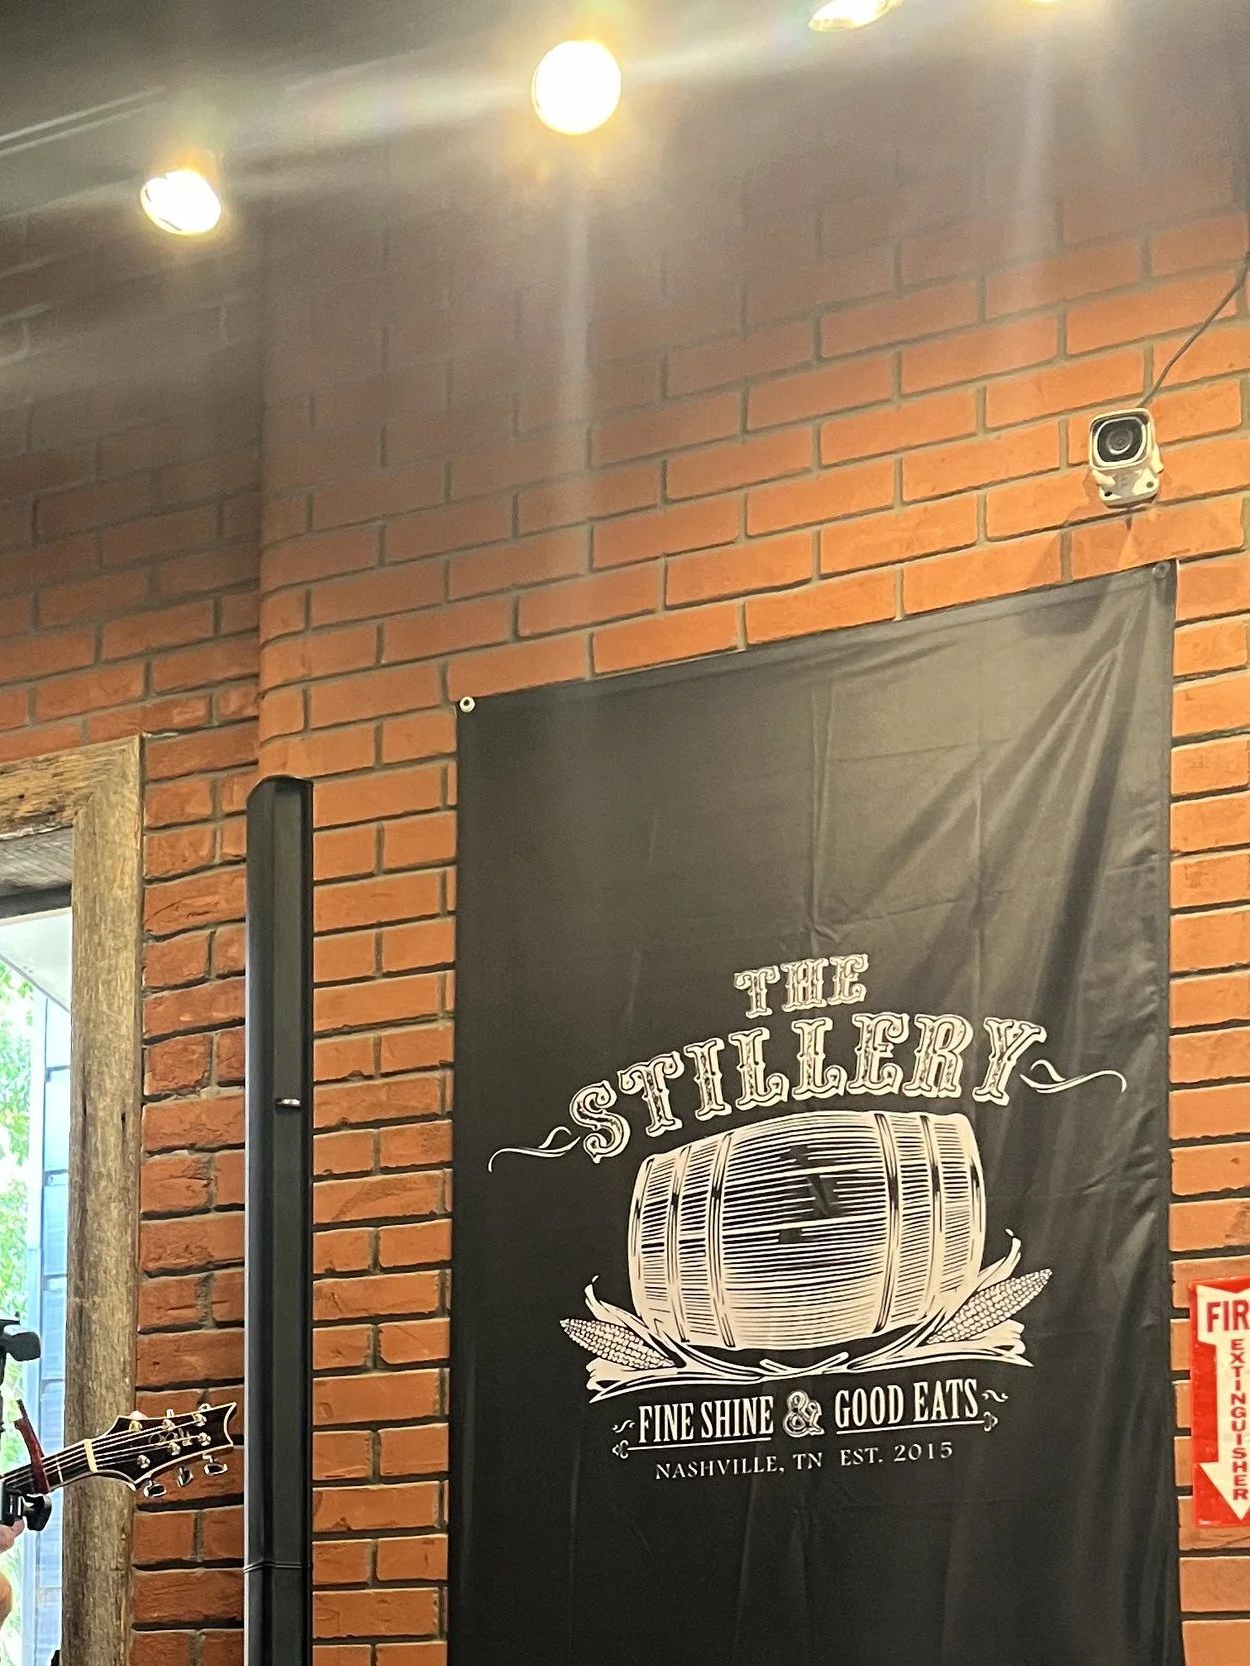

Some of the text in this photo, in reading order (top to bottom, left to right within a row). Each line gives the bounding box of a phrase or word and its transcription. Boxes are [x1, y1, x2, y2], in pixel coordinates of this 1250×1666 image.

[734, 953, 868, 1018] THE
[569, 1012, 1047, 1164] STILLERY
[638, 1378, 979, 1443] FINE SHINE & GOOD EATS
[1230, 1338, 1249, 1501] EXTINGUISHER
[655, 1441, 953, 1480] NASHVILLE, TN EST. 2015
